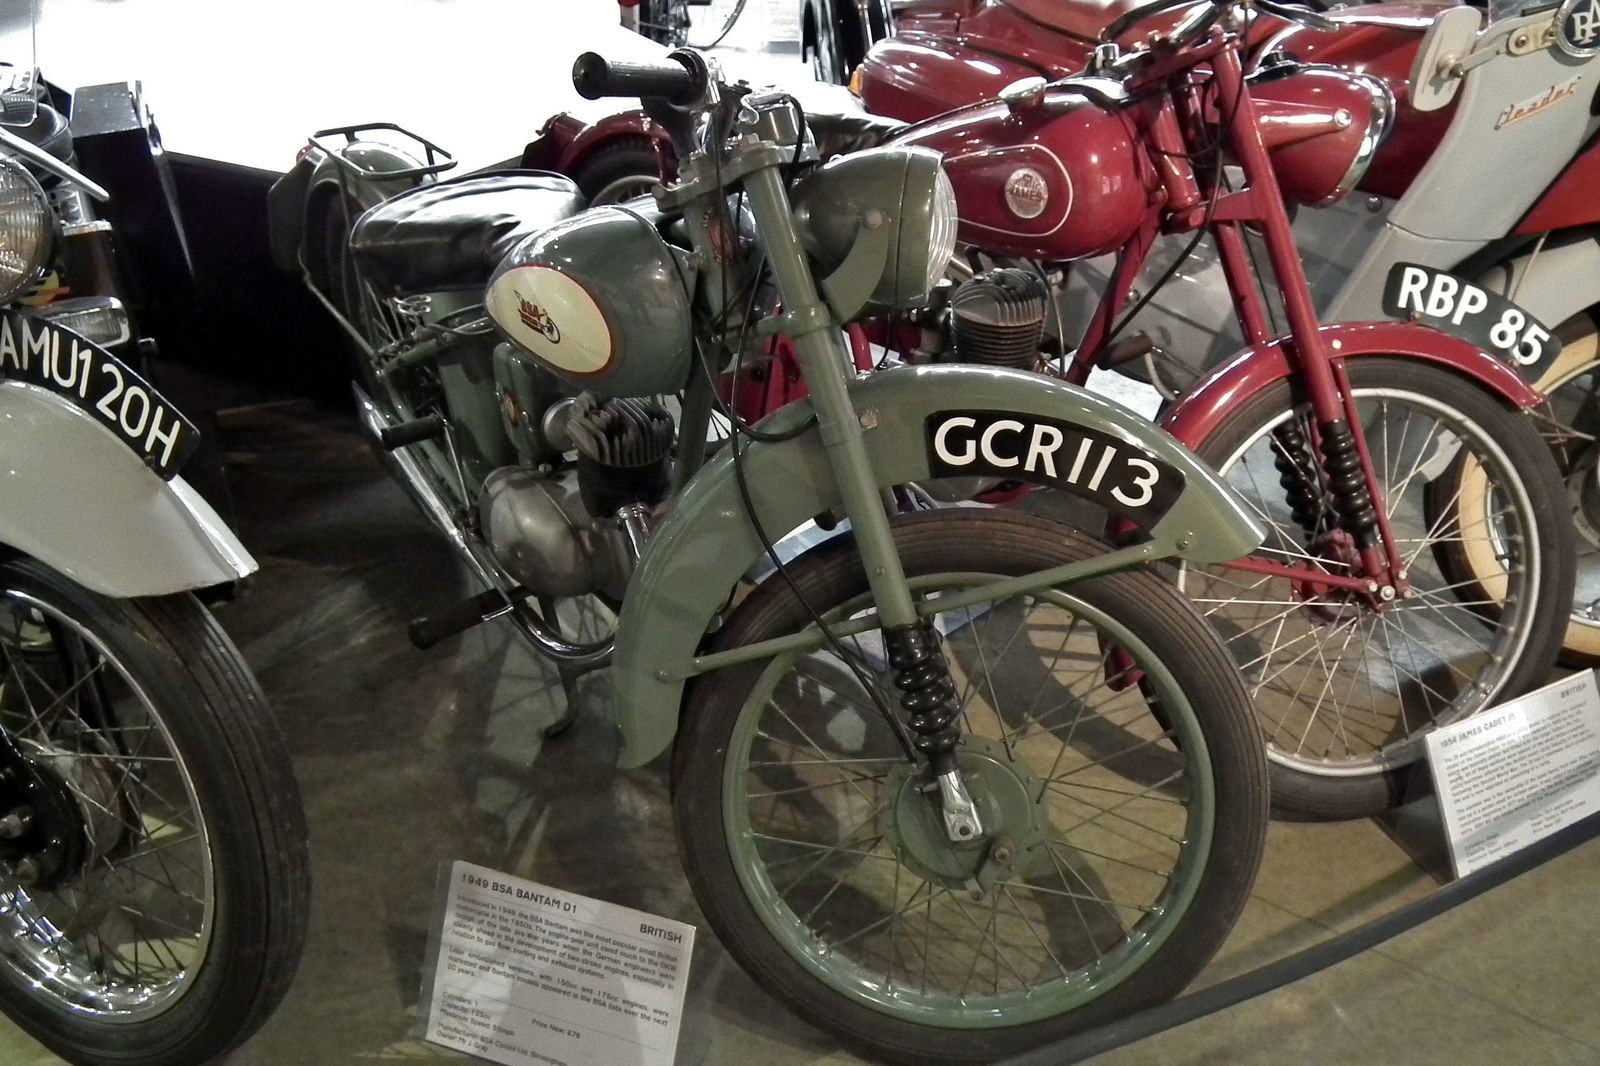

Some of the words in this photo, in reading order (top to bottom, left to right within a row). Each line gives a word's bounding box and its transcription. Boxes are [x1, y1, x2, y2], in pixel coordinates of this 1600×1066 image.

[1398, 267, 1488, 325] RBP
[1489, 308, 1551, 366] 85
[461, 873, 489, 889] 1949
[491, 881, 513, 896] BSA
[515, 888, 560, 909] BANTAM
[563, 901, 576, 914] D1
[639, 923, 682, 943] BRITISH
